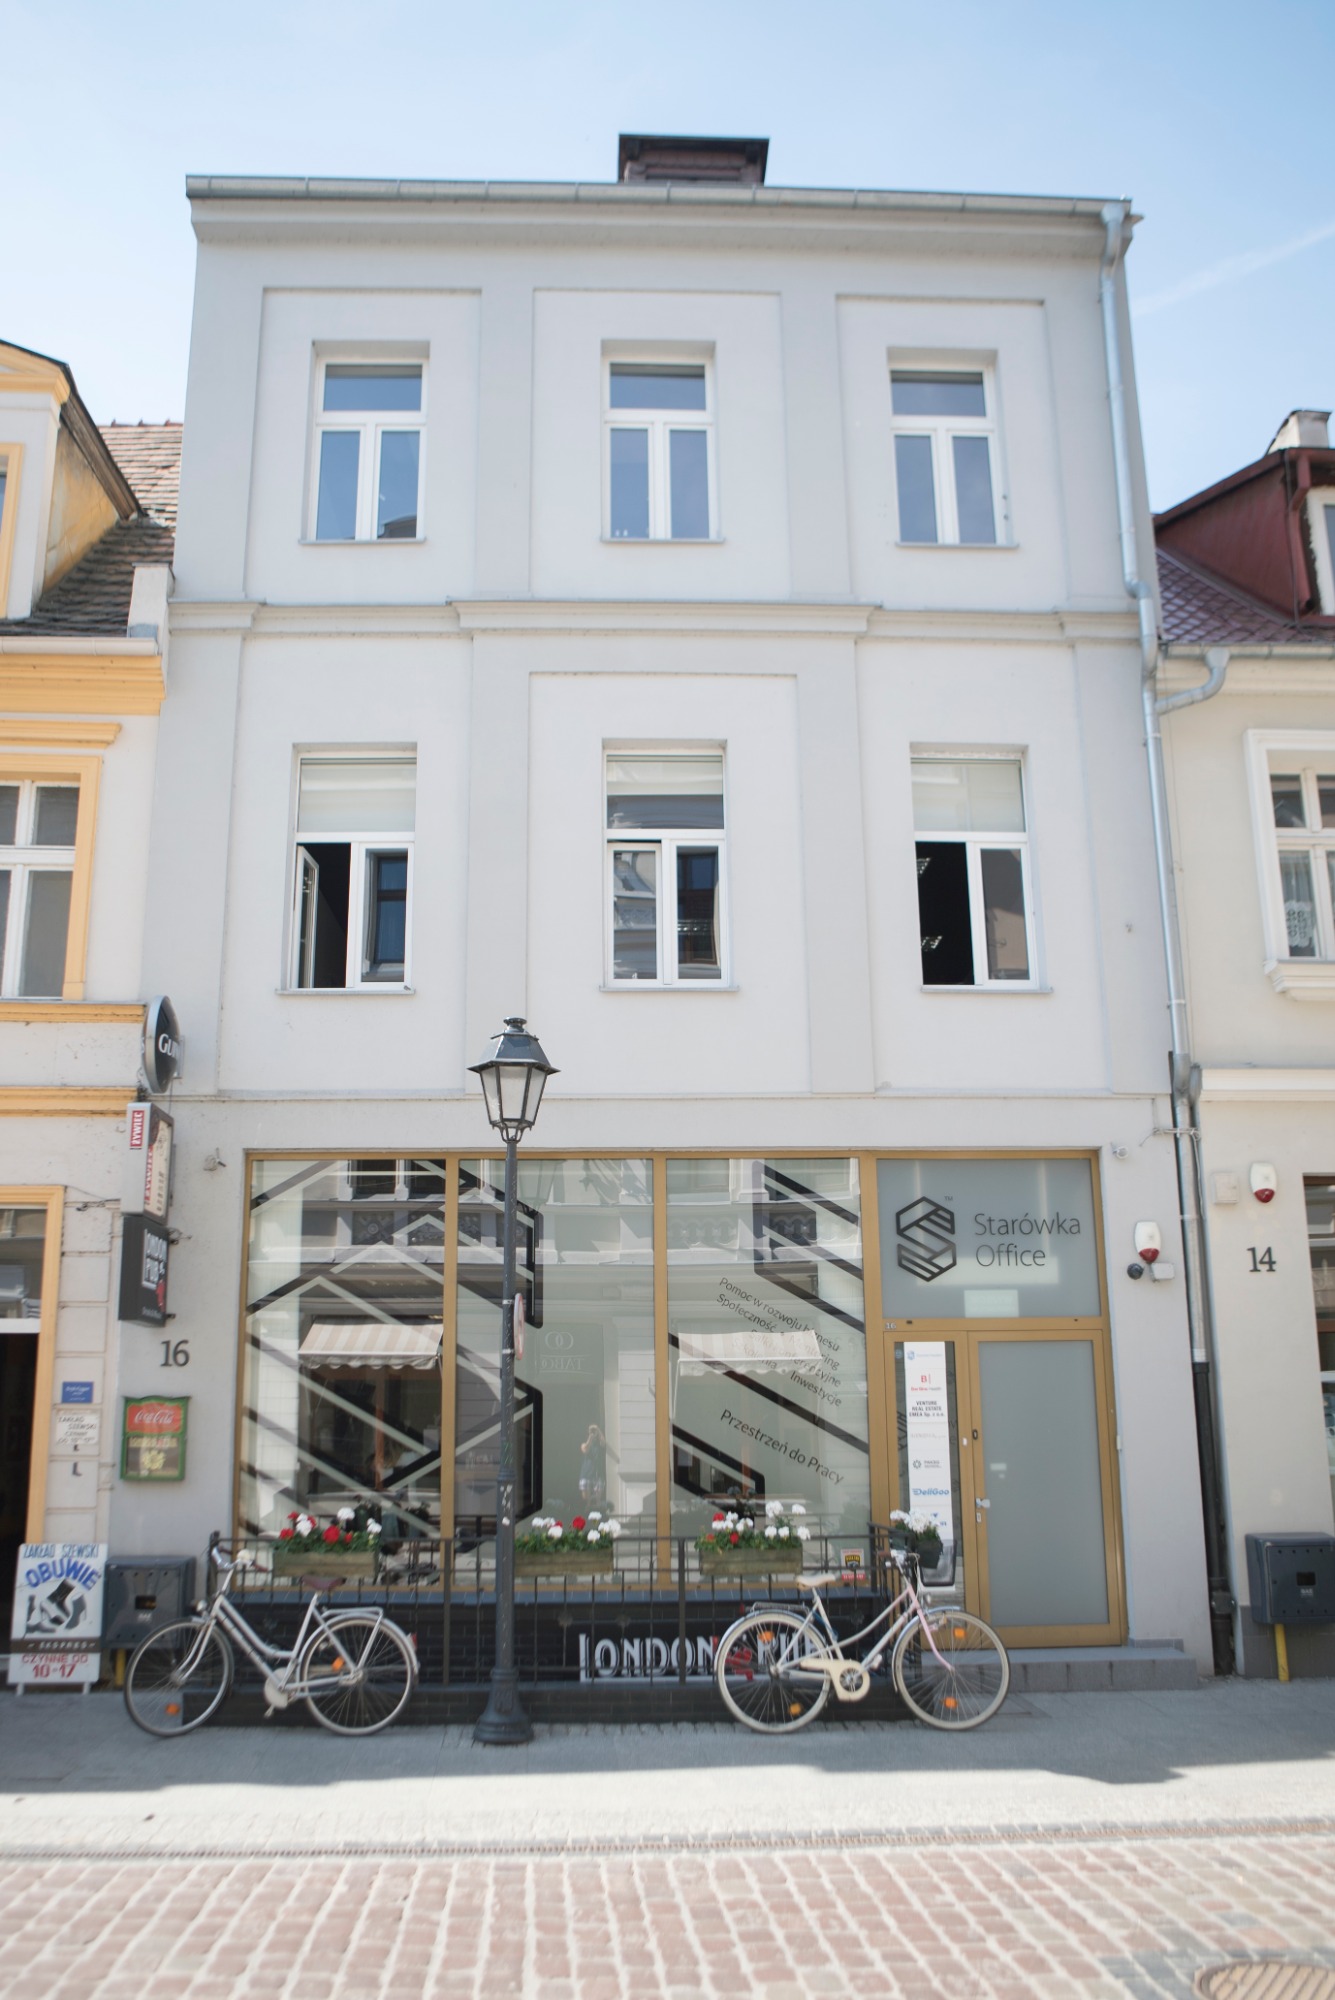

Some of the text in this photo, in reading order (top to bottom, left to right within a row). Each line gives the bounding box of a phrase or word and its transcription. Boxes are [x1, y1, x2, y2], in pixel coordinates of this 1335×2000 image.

[974, 1211, 1081, 1235] Starówka
[975, 1243, 1046, 1267] Office
[1246, 1246, 1276, 1272] 14
[716, 1293, 777, 1333] Społeczność
[719, 1277, 753, 1303] Pomoc
[763, 1304, 803, 1332] rozwoju
[160, 1339, 191, 1367] 16
[790, 1371, 843, 1407] Inwestycje
[720, 1409, 845, 1486] Przestrzeń do Pracy
[912, 1487, 950, 1496] DeliGoo
[24, 1545, 99, 1559] ZAKŁAD SZEWSKI
[25, 1559, 99, 1591] OBUWIE
[22, 1654, 66, 1664] CZYNNE
[578, 1633, 714, 1680] LONDON
